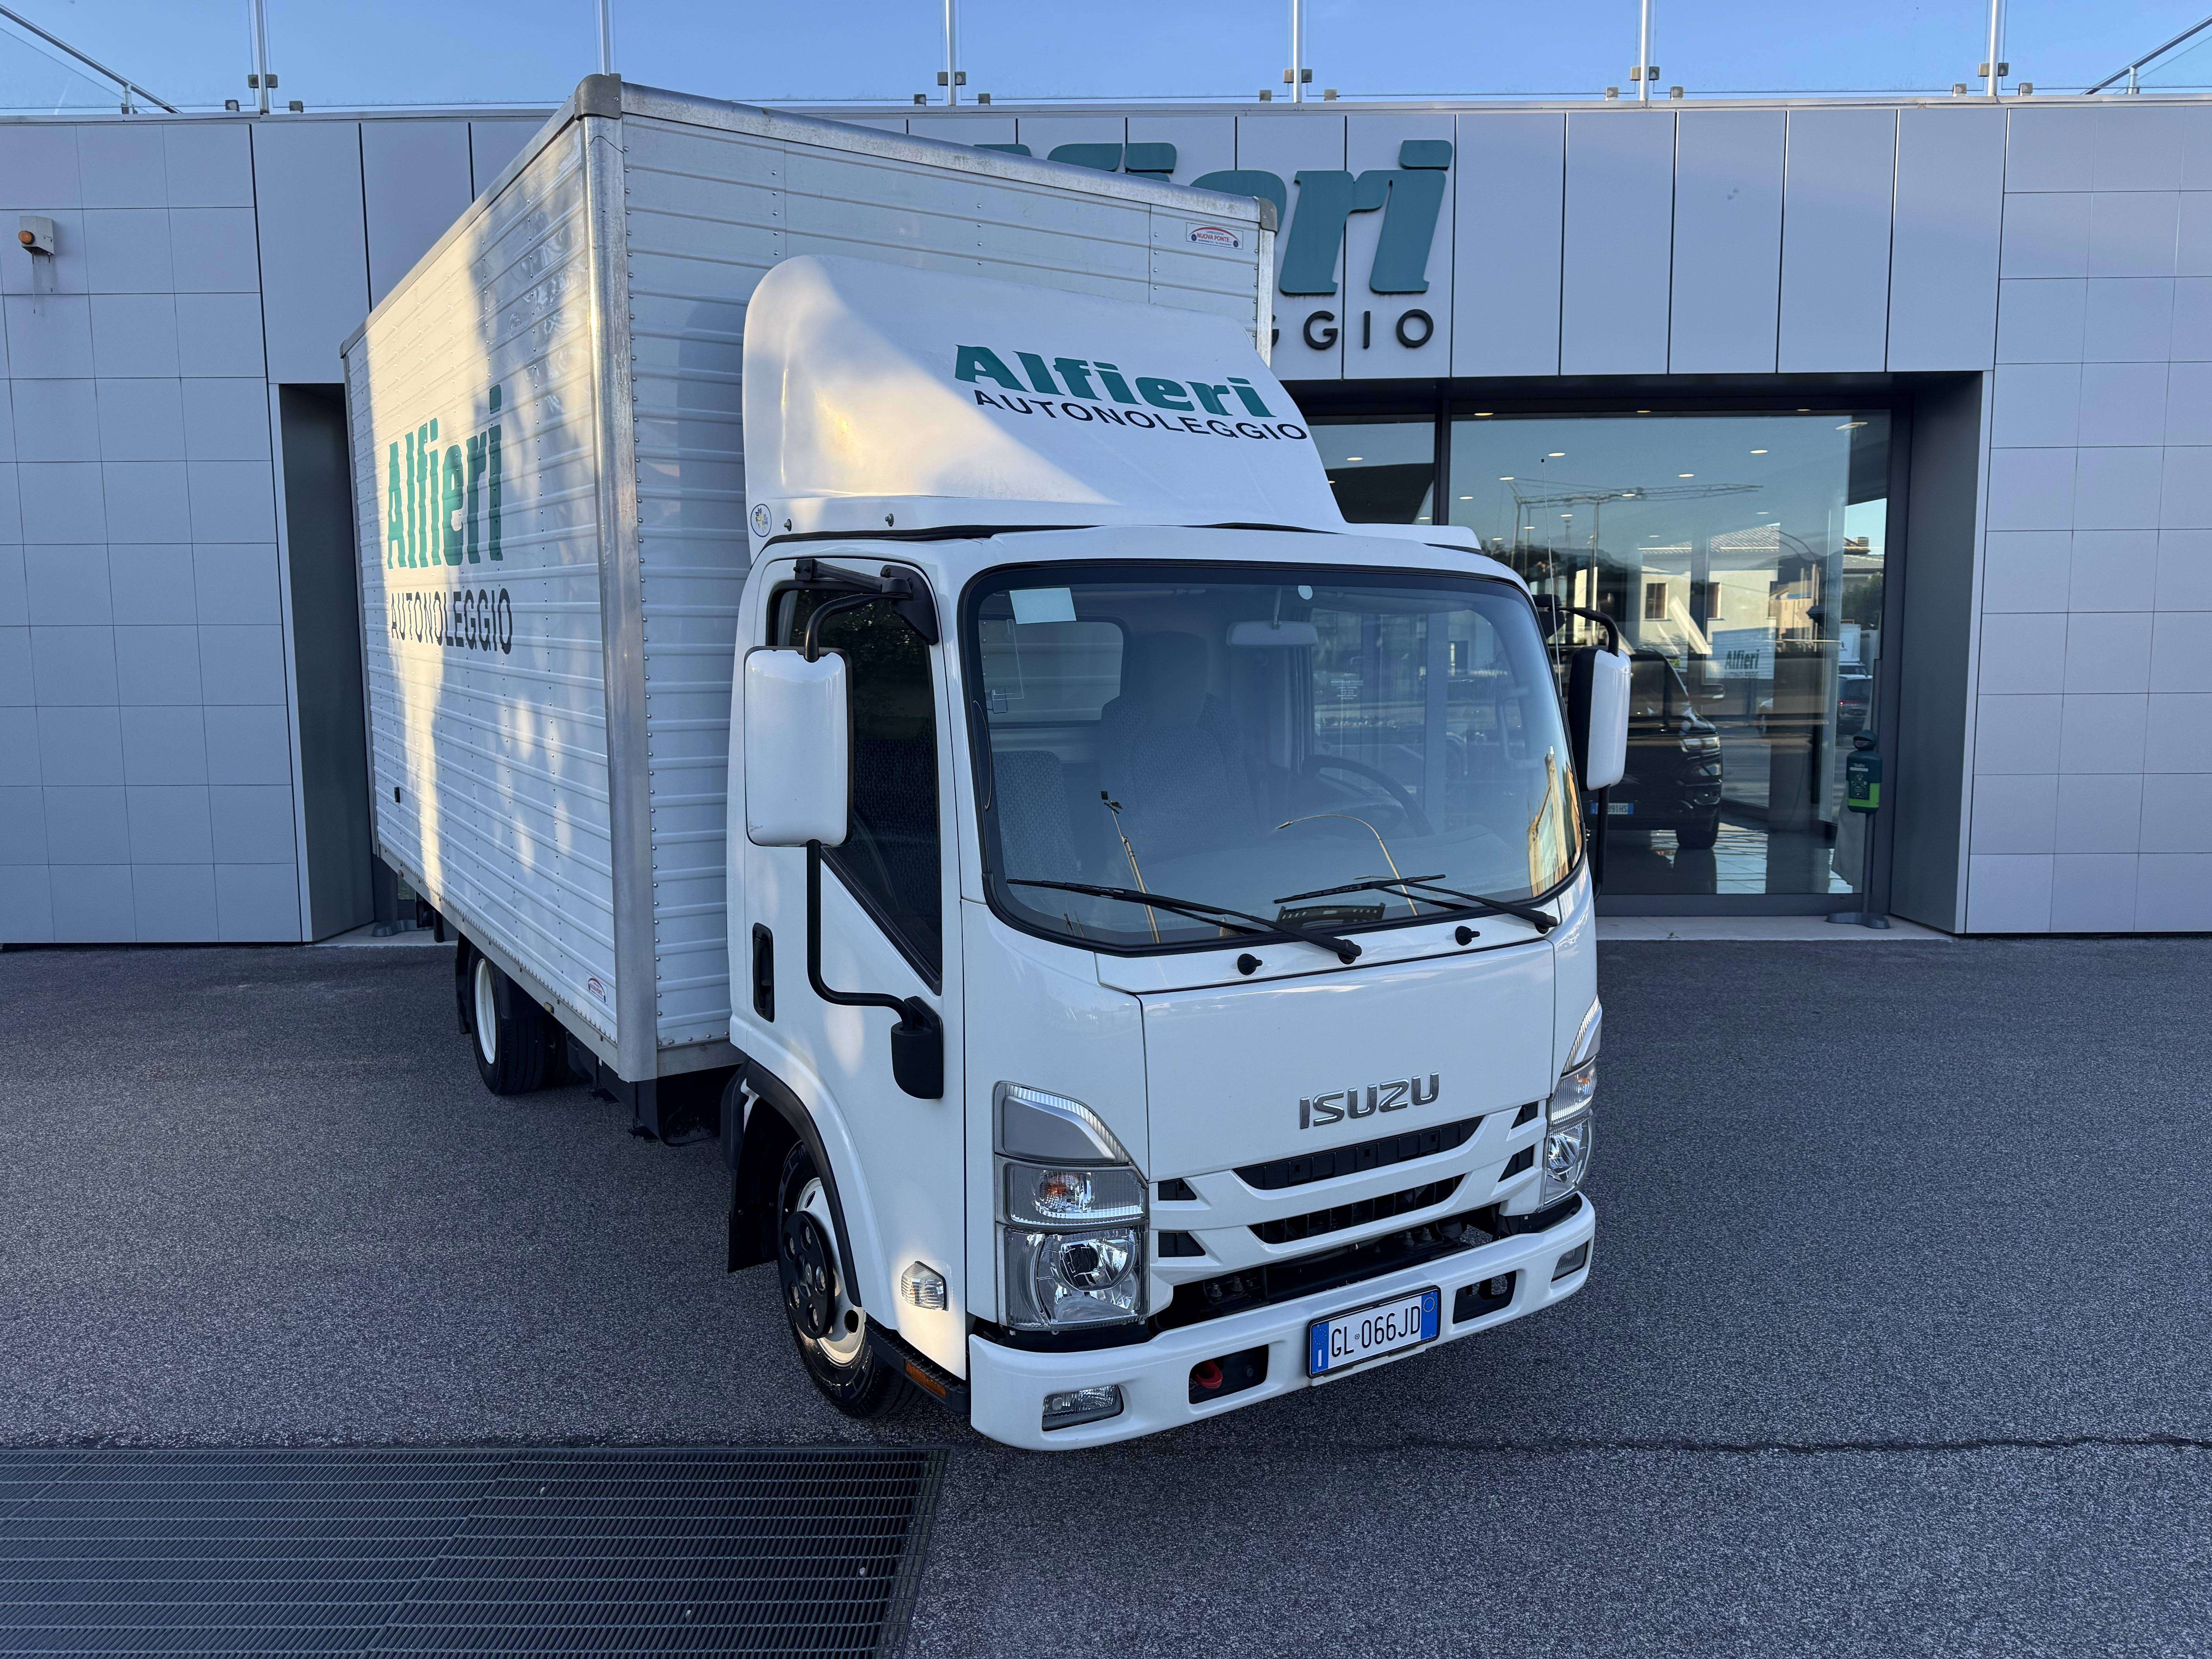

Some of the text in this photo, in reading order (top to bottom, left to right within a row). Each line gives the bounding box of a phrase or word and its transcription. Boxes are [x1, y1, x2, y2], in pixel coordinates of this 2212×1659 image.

[1272, 309, 1434, 350] GIO
[955, 344, 1277, 417] Alfieri
[976, 390, 1307, 440] AUTONOLEGGIO
[387, 384, 503, 569] Alfieri
[392, 588, 513, 655] AUTONOLEGGIO
[1725, 649, 1760, 669] Alfieri
[1300, 1072, 1439, 1129] ISUZU
